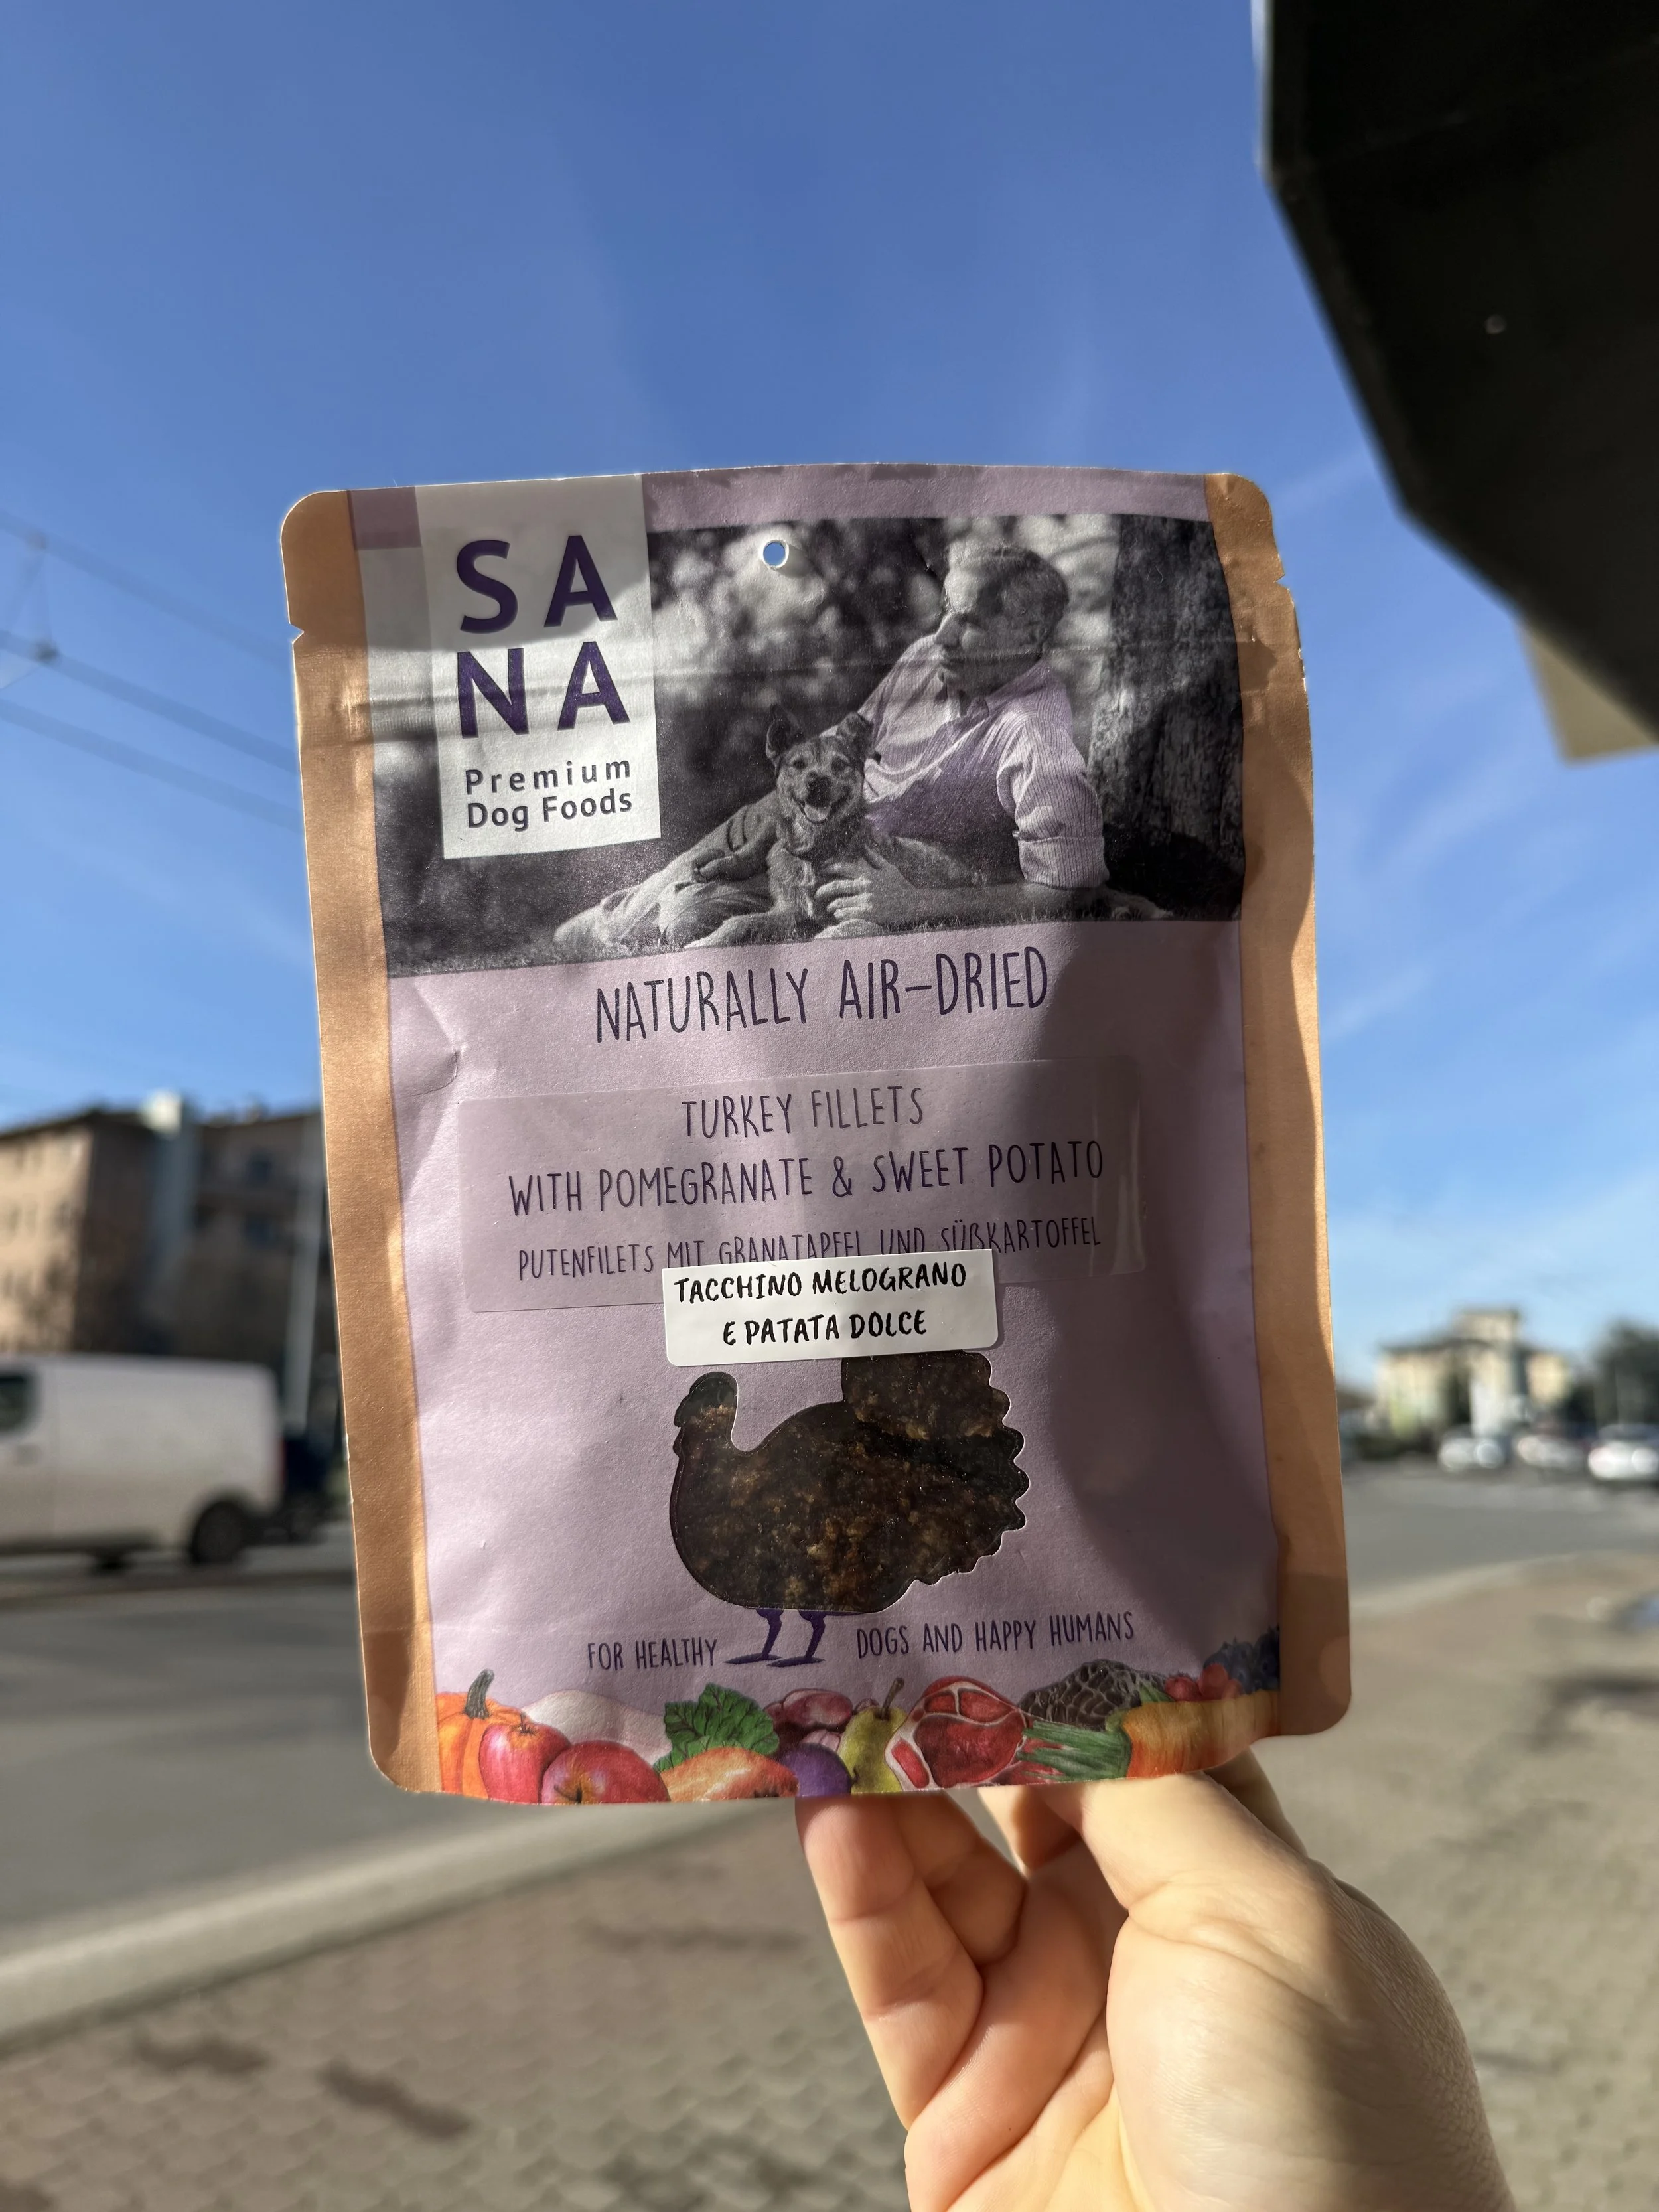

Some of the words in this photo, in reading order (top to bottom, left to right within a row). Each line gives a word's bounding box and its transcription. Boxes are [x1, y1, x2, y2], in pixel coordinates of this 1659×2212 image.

[456, 535, 618, 634] SA
[457, 641, 631, 739] NA
[465, 759, 630, 795] Premium
[467, 802, 528, 832] Dog
[543, 788, 632, 823] Foods
[597, 968, 808, 1043] NATURALLY
[839, 946, 1048, 1019] AIR-DRIED
[682, 1094, 792, 1138] TURKEY
[810, 1086, 923, 1129] FILLETS
[508, 1171, 582, 1216] WITH
[599, 1157, 813, 1211] POMEGRANATE
[831, 1155, 853, 1197] &
[871, 1147, 969, 1193] SWEET
[989, 1140, 1104, 1188] POTATO
[519, 1244, 654, 1281] PUTENFILETS
[667, 1240, 705, 1268] MIT
[879, 1227, 926, 1254] UND
[674, 1272, 802, 1303] TACCHINO
[812, 1261, 967, 1295] MELOGRANO
[723, 1321, 736, 1345] E
[744, 1313, 839, 1344] PATATA
[849, 1309, 927, 1339] DOLCE
[588, 1641, 624, 1670] FOR
[635, 1637, 717, 1669] HEALTHY
[857, 1626, 909, 1659] DOGS
[922, 1623, 963, 1653] AND
[975, 1618, 1037, 1651] HAPPY
[1050, 1611, 1135, 1646] HUMANS
